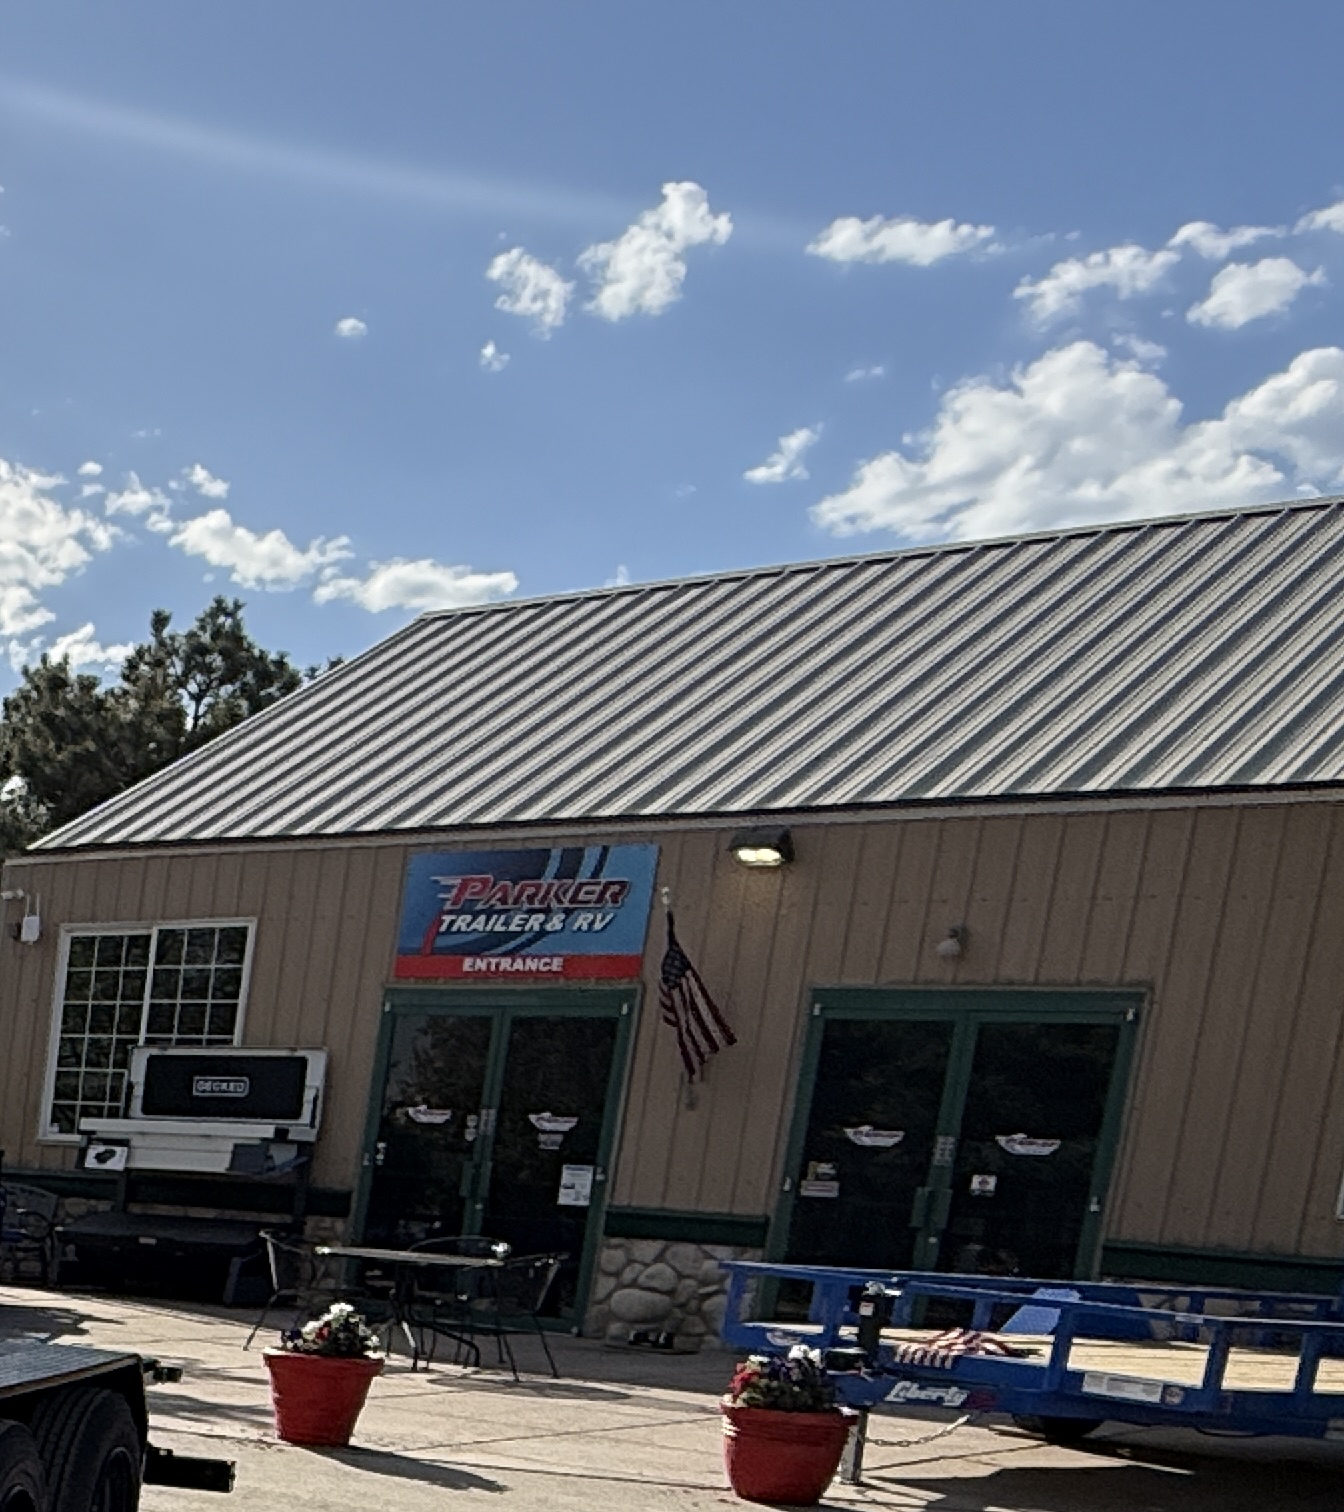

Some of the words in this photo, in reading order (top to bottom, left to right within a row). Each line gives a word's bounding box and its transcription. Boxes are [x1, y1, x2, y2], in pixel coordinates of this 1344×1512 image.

[430, 874, 630, 911] PARKER
[439, 913, 545, 933] TRAILER
[543, 913, 564, 932] &
[572, 912, 615, 932] RV
[462, 956, 563, 973] ENTRANCE
